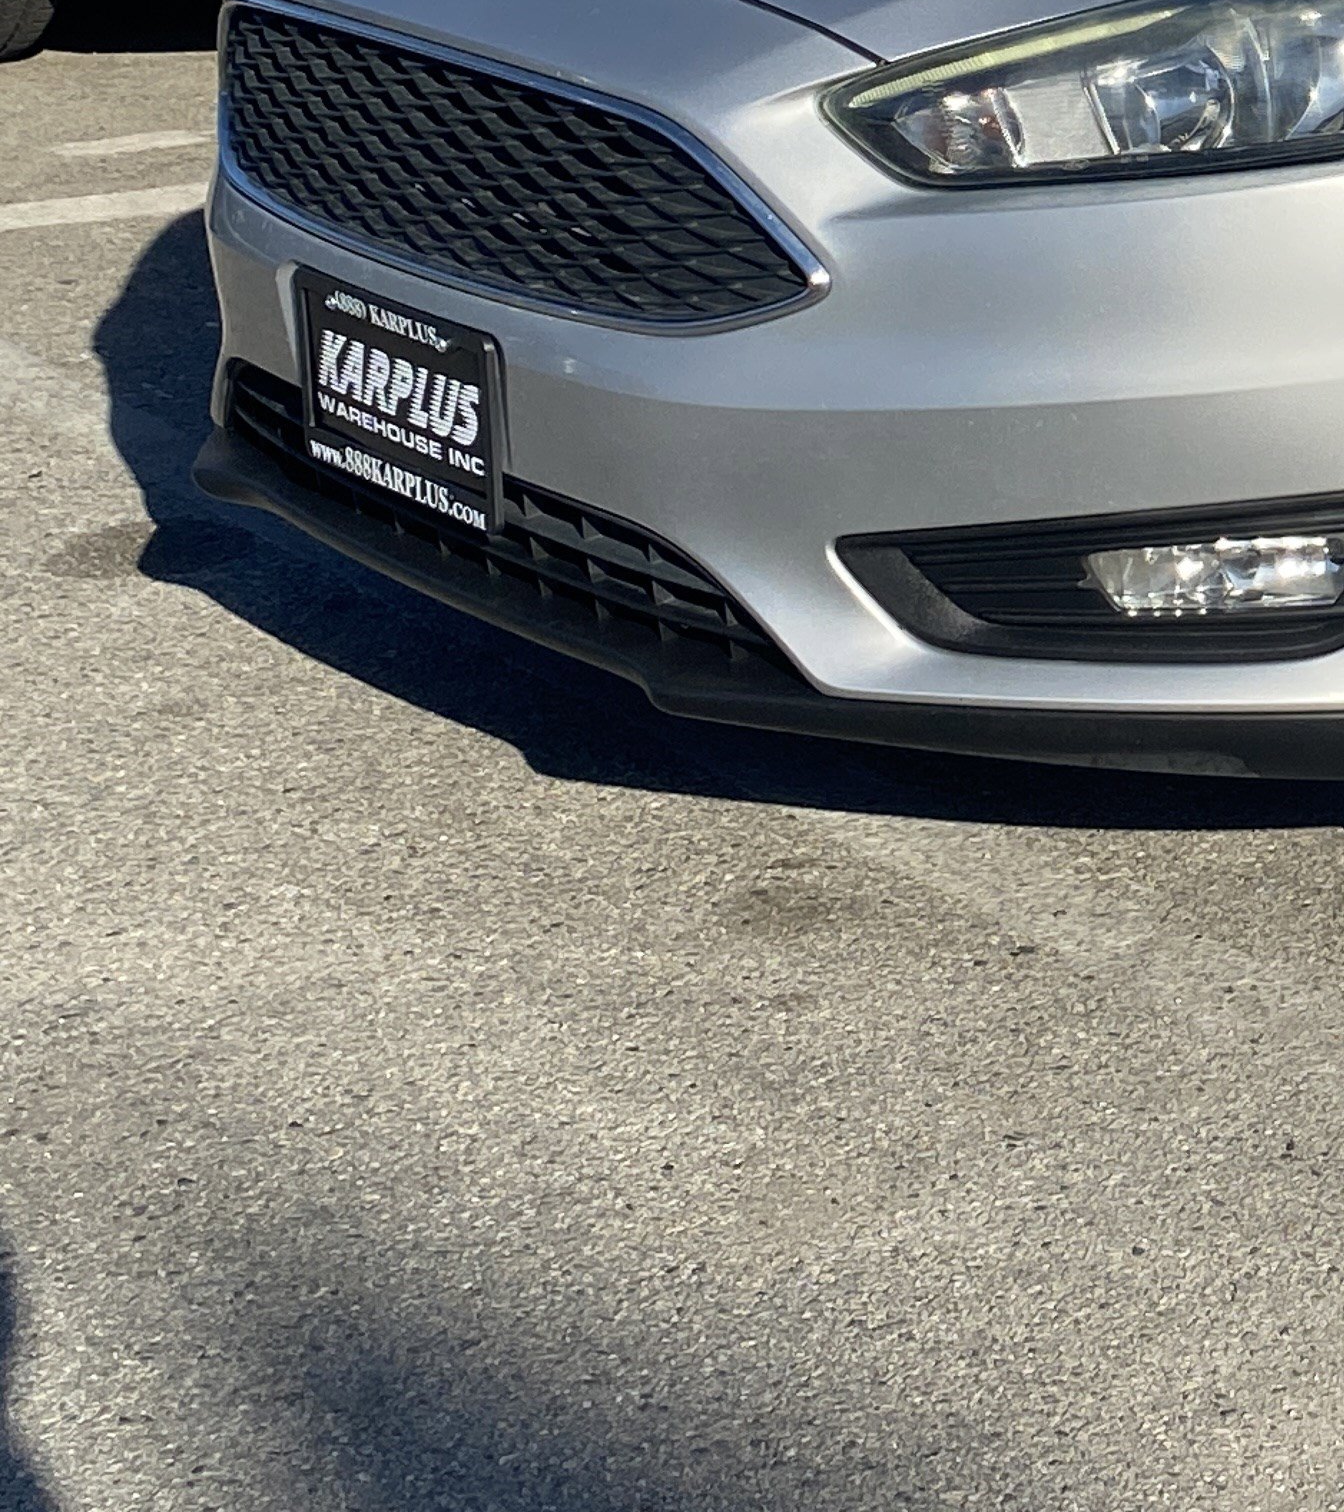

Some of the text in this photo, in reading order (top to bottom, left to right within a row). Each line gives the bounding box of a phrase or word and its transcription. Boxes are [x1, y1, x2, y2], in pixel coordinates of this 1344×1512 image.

[367, 303, 438, 347] KARPLUS
[317, 328, 481, 447] KARPLUS
[317, 391, 486, 477] WAREHOUSE INC
